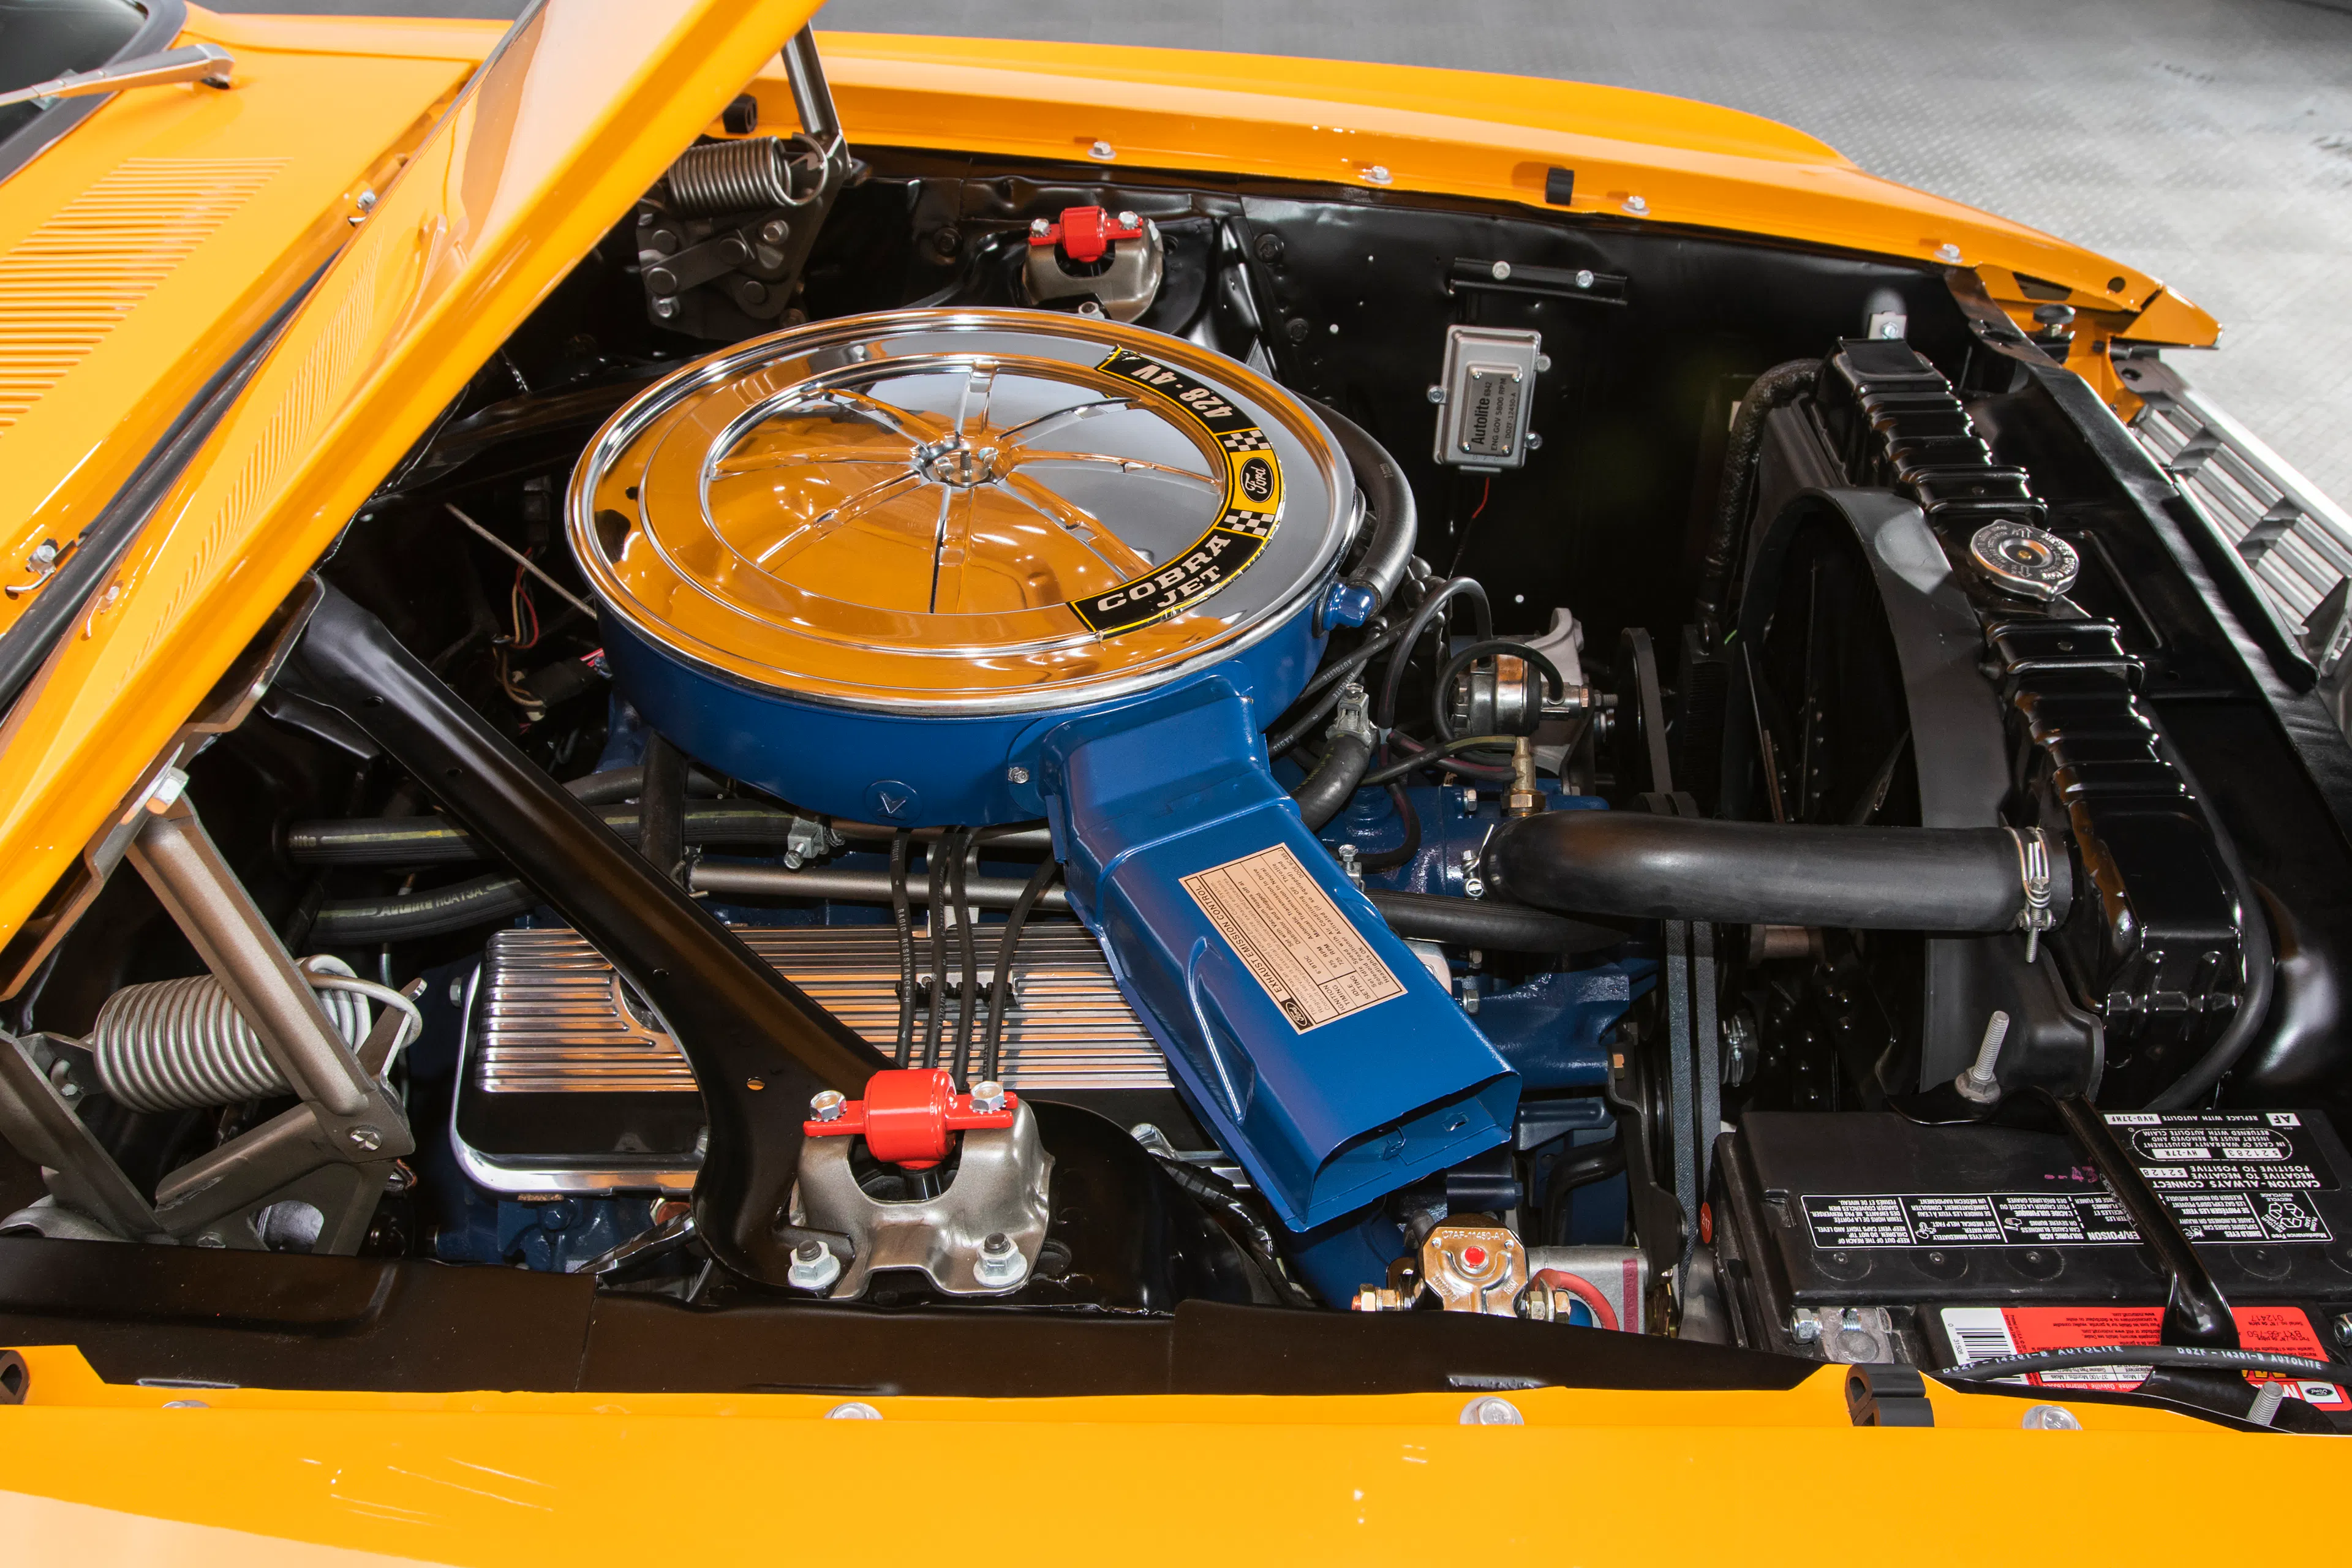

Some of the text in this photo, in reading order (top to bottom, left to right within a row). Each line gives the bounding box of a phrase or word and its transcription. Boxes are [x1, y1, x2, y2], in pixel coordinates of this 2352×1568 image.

[1471, 398, 1490, 445] Autolite
[1243, 467, 1273, 495] Ford
[1098, 534, 1232, 612] COBRA
[1156, 565, 1221, 608] JET
[1322, 658, 1352, 682] AUTOLITE
[891, 839, 900, 862] AUTOLITE
[1259, 867, 1276, 884] Neutral
[1270, 863, 1289, 882] Throttle
[1276, 861, 1287, 870] and
[1247, 894, 1262, 908] Hoses
[1266, 886, 1294, 916] Transmission
[1278, 890, 1306, 920] Transmission
[1297, 895, 1327, 927] Conditioning
[897, 908, 907, 932] RADIO
[1259, 908, 1278, 928] Vacuum
[1270, 911, 1281, 921] and
[1319, 911, 1341, 935] Activated
[1274, 927, 1287, 939] with
[1278, 921, 1301, 944] Distributor
[1291, 916, 1314, 940] Automatic
[1303, 920, 1321, 937] Manual
[1284, 938, 1294, 947] Set
[1316, 946, 1329, 957] RPM
[1322, 943, 1336, 955] RPM
[1331, 936, 1344, 947] with
[1340, 936, 1364, 961] Positioner
[1193, 885, 1305, 1023] Ford EXHAUST EMISSION CONTROL
[1303, 954, 1317, 969] BTDC
[1327, 959, 1338, 968] 675
[1334, 956, 1345, 965] 725
[1342, 948, 1360, 965] Speed
[901, 938, 911, 1003] RESISTANCE-H
[1356, 966, 1368, 977] Idle
[1362, 962, 1384, 985] Solenoid
[1364, 954, 1391, 982] Headlights
[1346, 983, 1360, 997] IDLE
[1348, 975, 1371, 999] SETTING
[1366, 978, 1378, 987] Set
[1322, 984, 1346, 1011] IGNITION
[1331, 984, 1351, 1005] TIMING
[937, 992, 946, 1030] AUTOLITE
[2057, 1344, 2125, 1358] AUTOLITE
[2269, 1354, 2323, 1371] AUTOLITE
